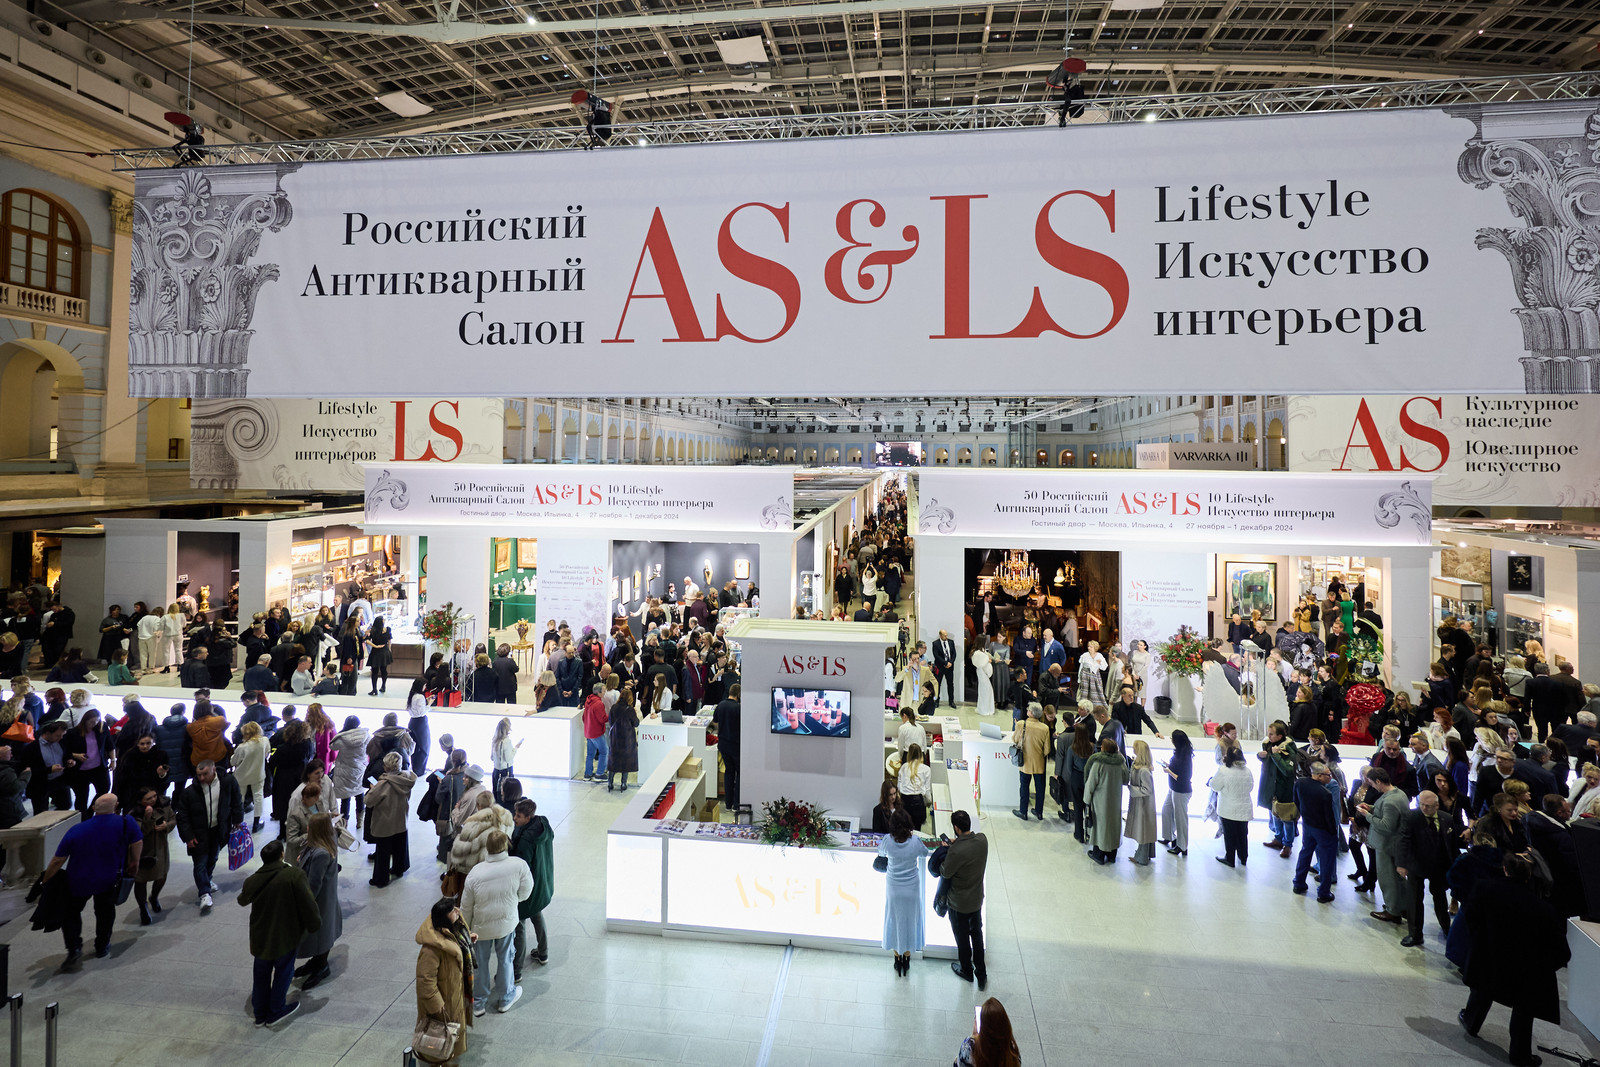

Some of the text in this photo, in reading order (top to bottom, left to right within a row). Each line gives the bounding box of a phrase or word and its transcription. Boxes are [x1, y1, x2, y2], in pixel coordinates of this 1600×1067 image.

[1155, 180, 1369, 229] Lifestyle
[342, 205, 587, 245] Российский
[1155, 242, 1428, 288] Искусство
[301, 258, 585, 303] Антикварный
[459, 311, 584, 345] Салон
[1154, 307, 1426, 345] интерьера
[317, 401, 378, 419] Lifestyle
[1465, 396, 1579, 414] Культурное
[1465, 414, 1551, 429] наследие
[302, 424, 377, 441] Искусство
[389, 400, 463, 462] LS
[1331, 396, 1451, 472] AS
[1174, 452, 1231, 462] VARVARKA
[1465, 440, 1579, 459] Ювелирное
[296, 451, 376, 464] интерьеров
[1465, 461, 1561, 476] искусство
[454, 483, 524, 492] 50 Российский
[609, 484, 664, 498] 10 Lifestyle
[429, 495, 524, 506] Антикварный Салон
[609, 496, 713, 511] Искусство интерьера
[1024, 491, 1107, 501] 50 Российский
[1210, 493, 1274, 506] 10 Lifestyle
[544, 511, 571, 519] Ильинка,
[994, 503, 1107, 515] Антикварный Салон
[1209, 505, 1335, 521] Искусство интерьера
[1031, 519, 1065, 528] Гостиный
[1066, 521, 1086, 529] двор
[1098, 521, 1129, 530] Москва,
[1131, 521, 1164, 530] Ильинка,
[1186, 522, 1196, 530] 27
[1198, 523, 1226, 531] ноября
[1240, 524, 1276, 532] декабря
[641, 733, 666, 742] ВХОД
